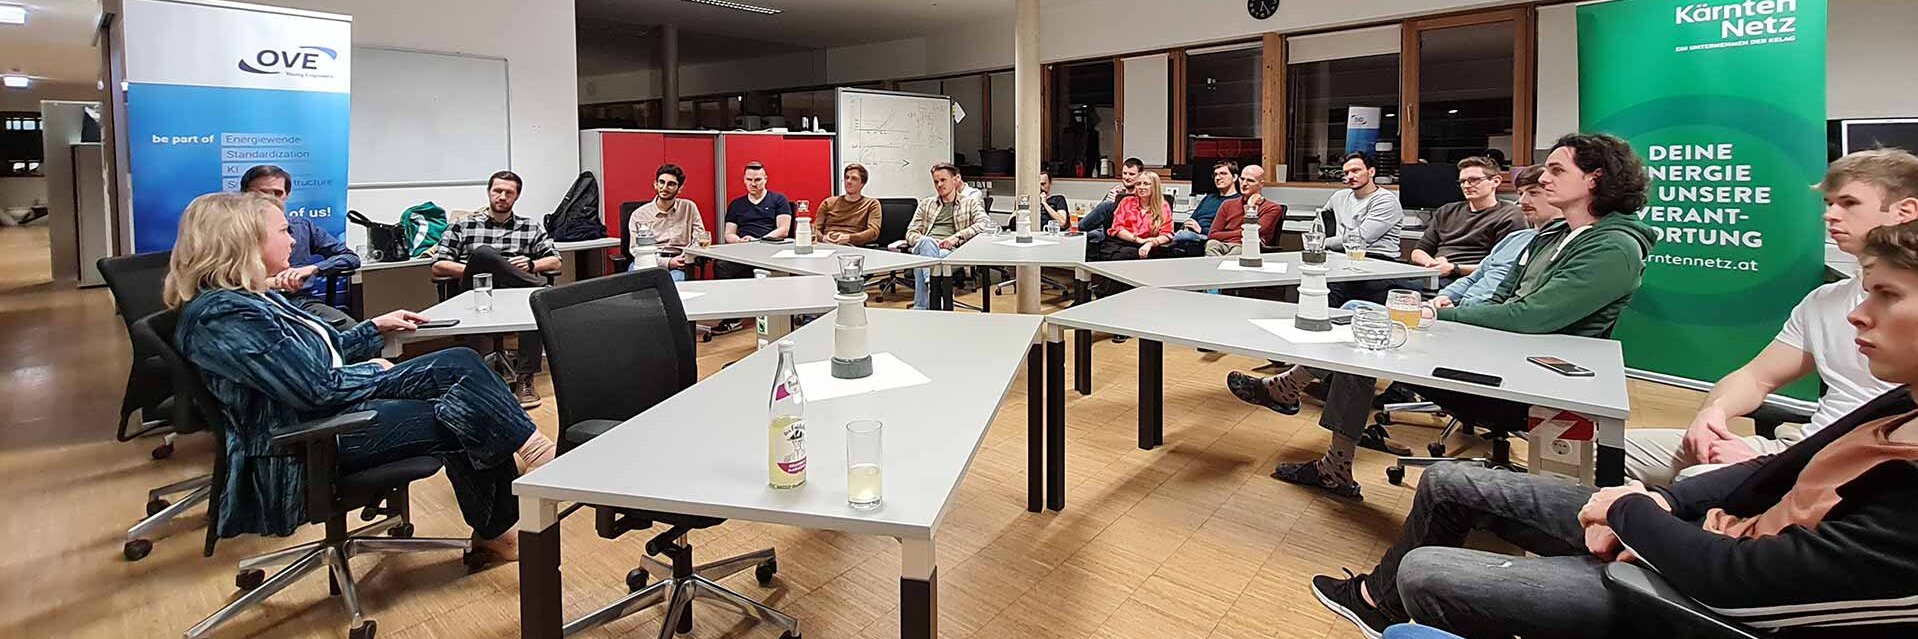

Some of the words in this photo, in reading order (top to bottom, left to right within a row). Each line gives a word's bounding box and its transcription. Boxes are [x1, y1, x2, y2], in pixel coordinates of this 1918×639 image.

[1675, 0, 1797, 25] Kärnten
[1721, 16, 1797, 39] Netz
[256, 49, 319, 70] OVE
[152, 134, 169, 144] be
[172, 135, 198, 145] part
[201, 134, 215, 144] of
[226, 134, 301, 145] Energiewende
[226, 150, 310, 159] Standardization
[1649, 143, 1733, 161] DEINE
[293, 178, 332, 187] tructure
[1643, 165, 1751, 182] NERGIE
[1658, 186, 1771, 204] UNSERE
[288, 207, 306, 217] of
[309, 207, 332, 217] us!
[1637, 206, 1749, 225] VERANT-
[1650, 226, 1763, 248] ORTUNG
